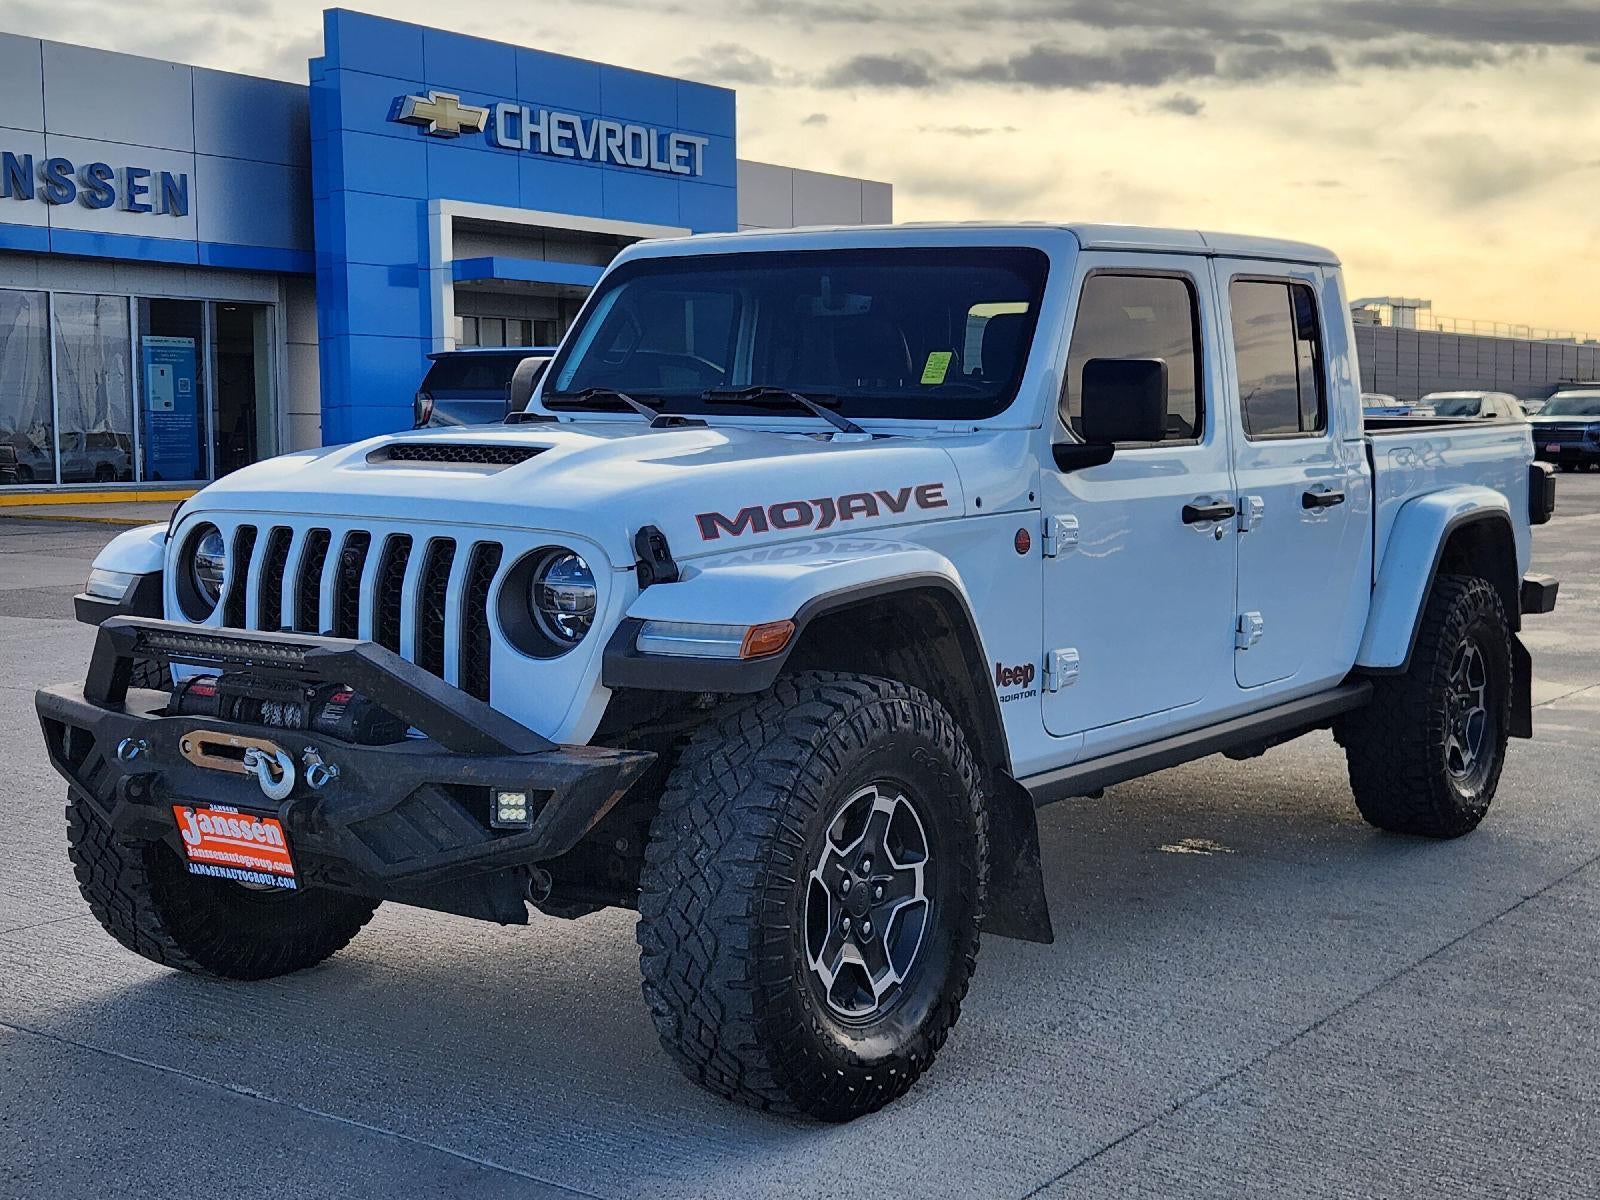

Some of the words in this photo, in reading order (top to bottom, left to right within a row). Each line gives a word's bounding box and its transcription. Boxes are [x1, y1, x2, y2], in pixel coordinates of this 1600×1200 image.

[493, 102, 709, 176] CHEVROLET
[694, 482, 949, 541] MOJAVE
[995, 662, 1035, 689] Jeep
[181, 811, 284, 846] Janssen
